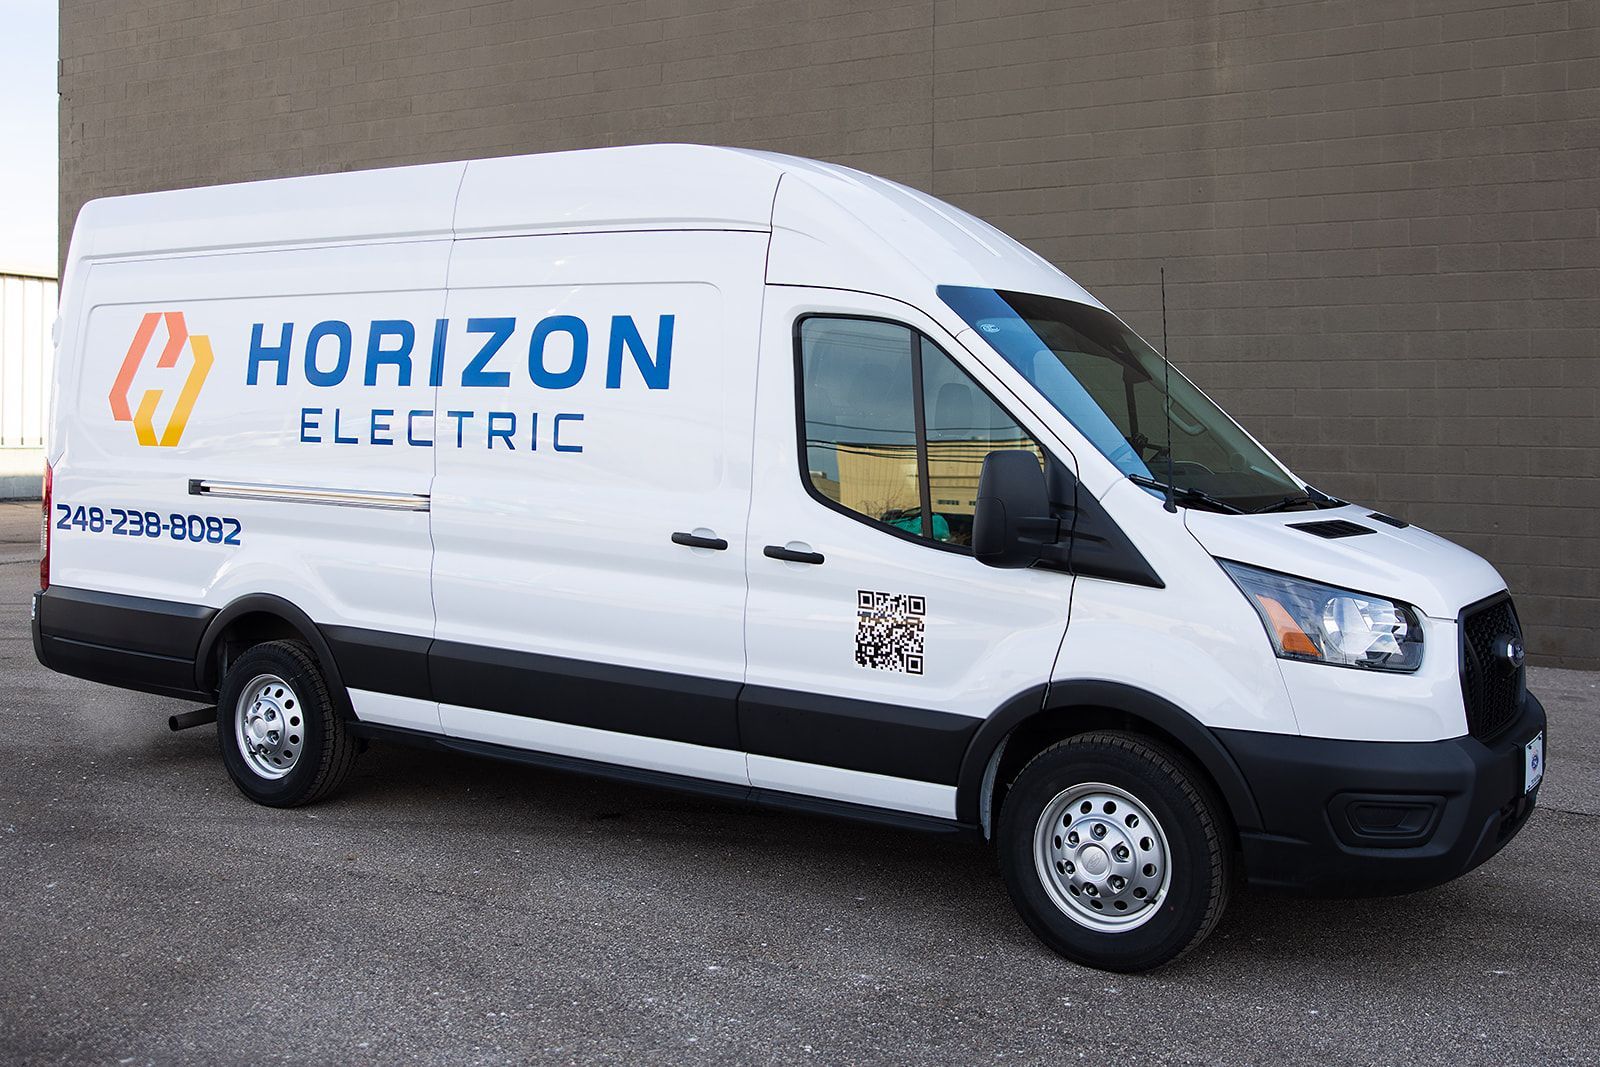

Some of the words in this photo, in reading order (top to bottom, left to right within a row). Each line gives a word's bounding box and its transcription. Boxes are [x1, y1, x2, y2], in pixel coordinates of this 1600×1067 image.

[246, 314, 676, 391] HORIZON
[299, 407, 585, 453] ELECTRIC
[56, 503, 242, 547] 248-238-8082
